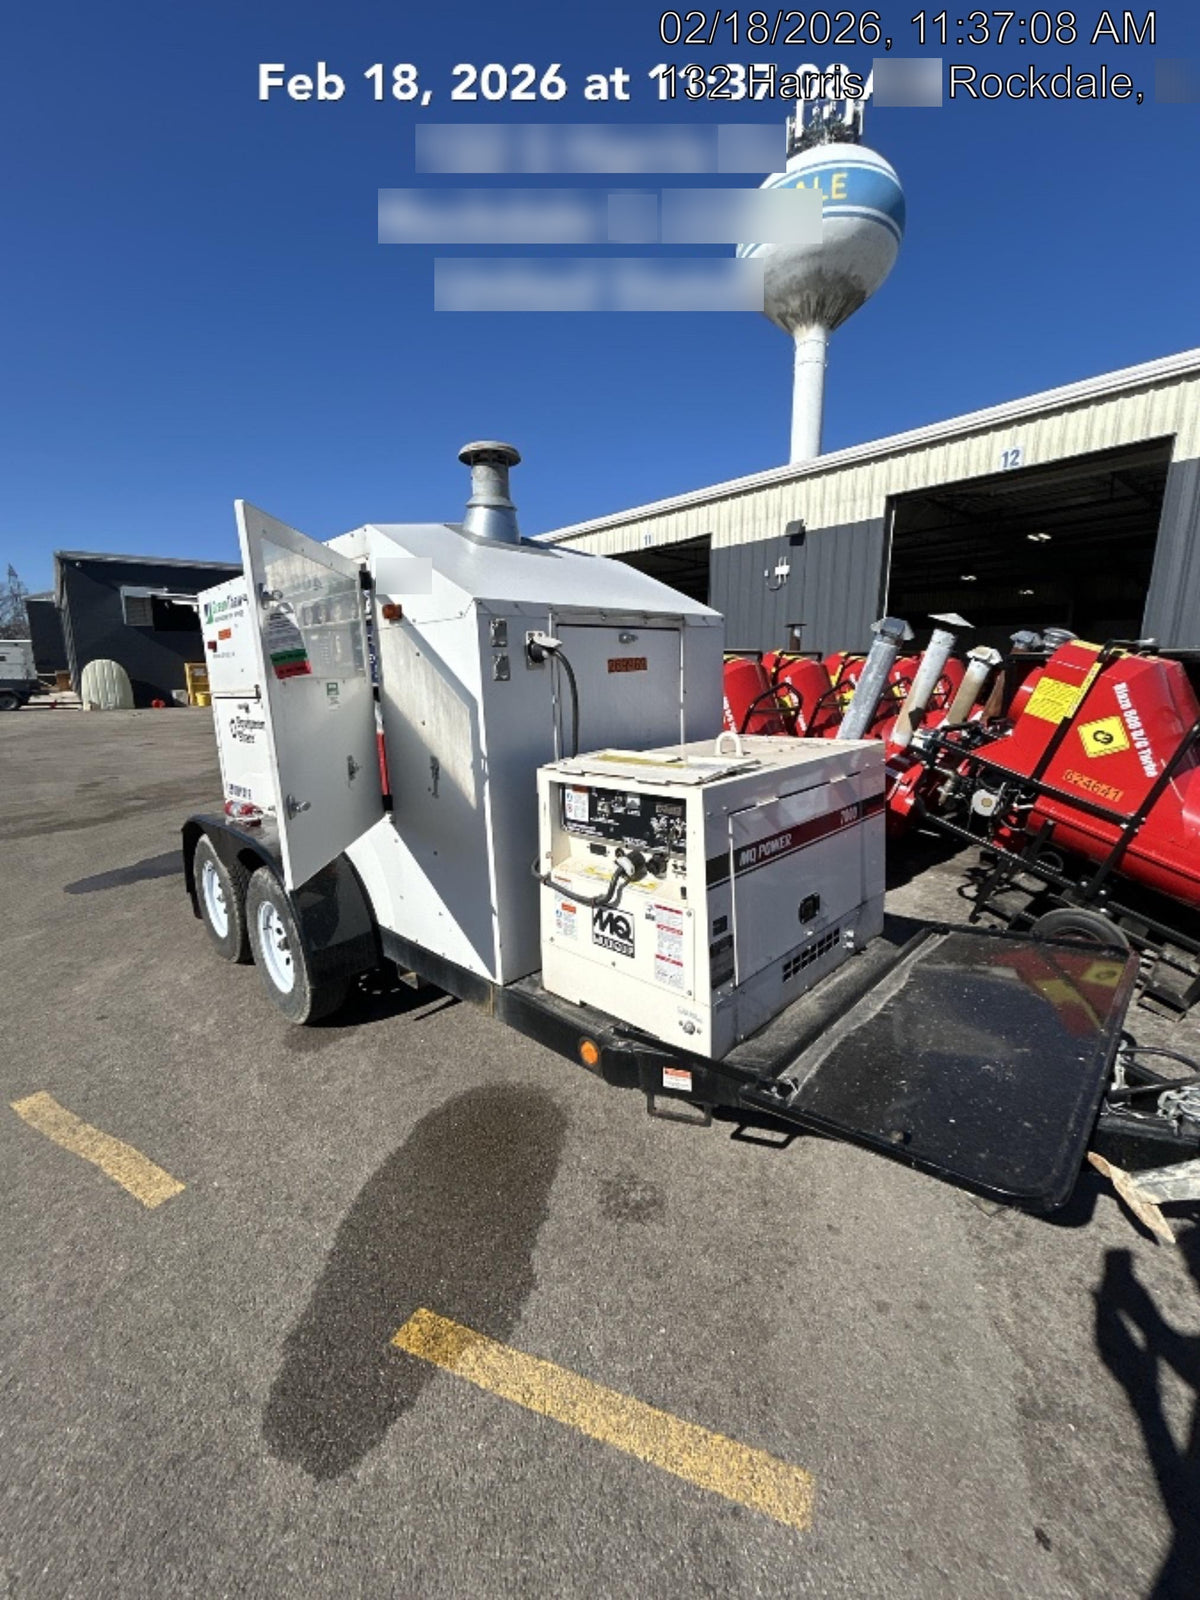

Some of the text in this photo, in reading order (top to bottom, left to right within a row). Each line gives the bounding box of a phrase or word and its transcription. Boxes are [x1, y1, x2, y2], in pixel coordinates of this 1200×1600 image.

[1001, 449, 1020, 468] 12
[643, 533, 652, 546] 11
[738, 833, 792, 867] MQ POWER
